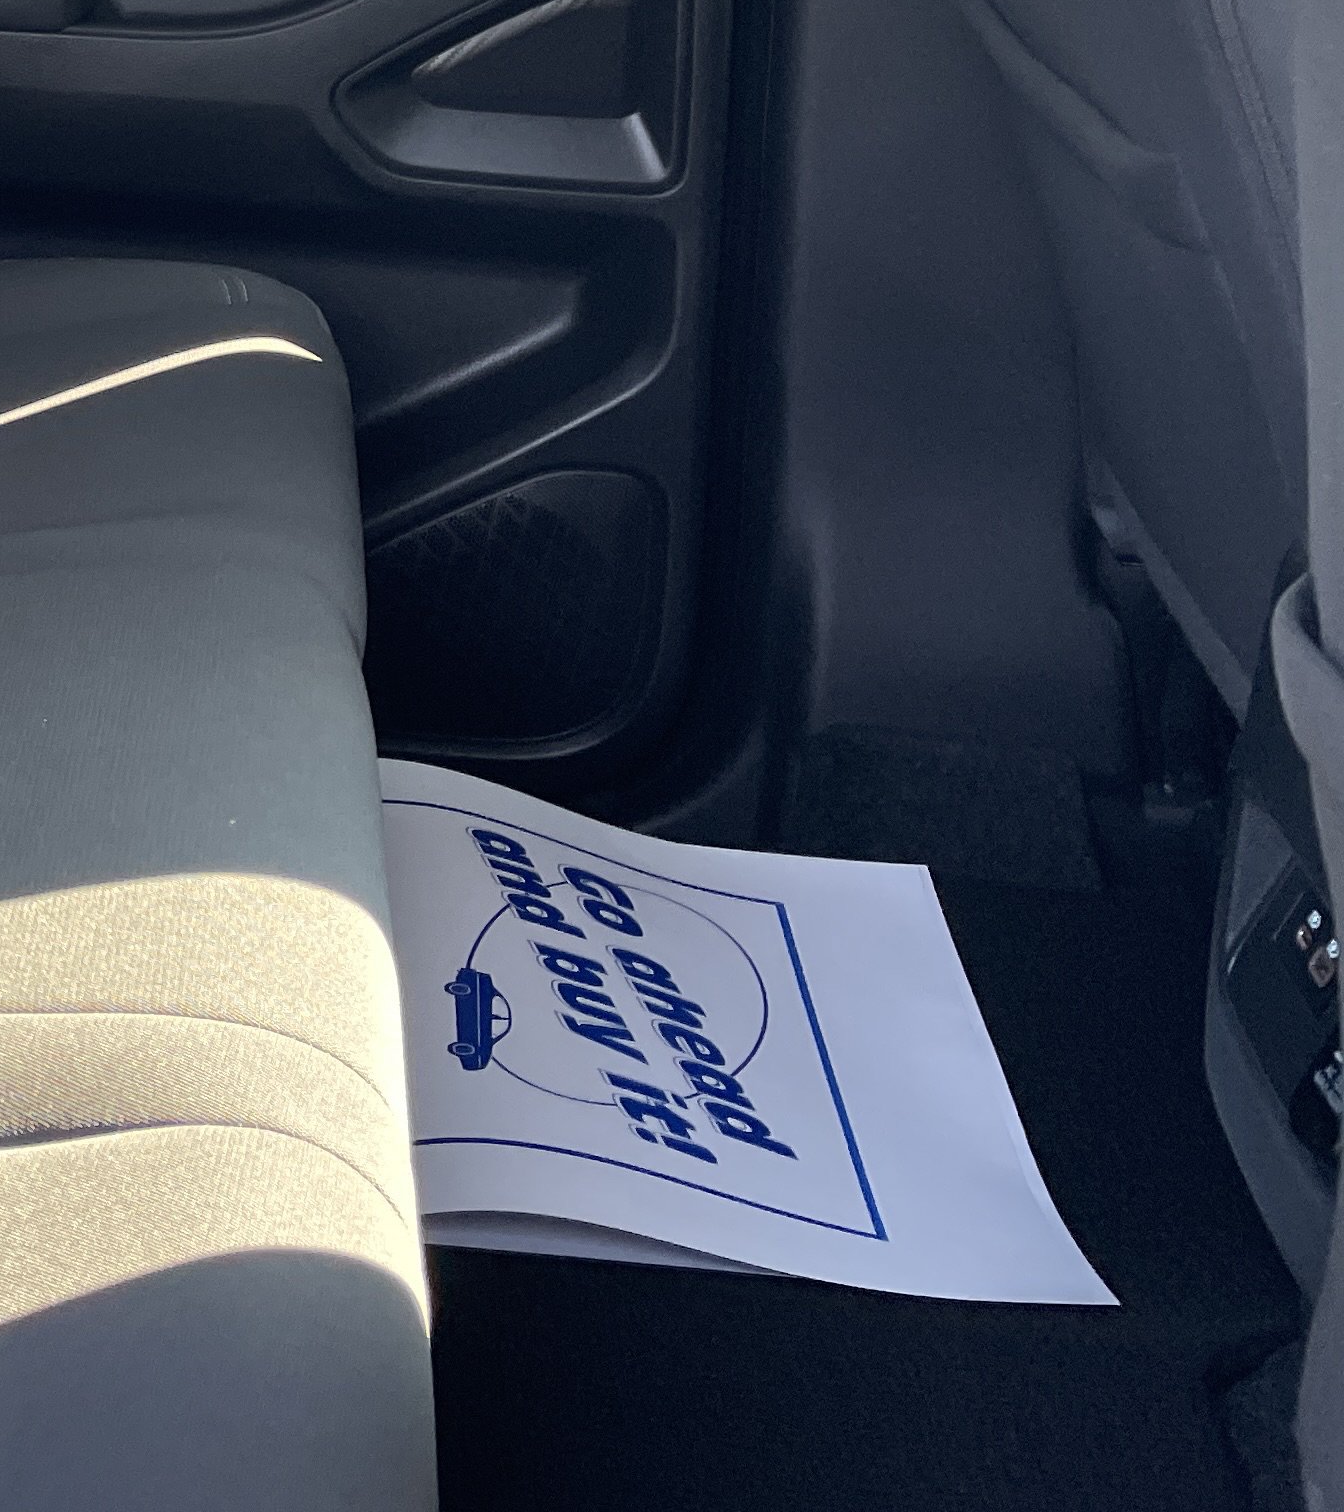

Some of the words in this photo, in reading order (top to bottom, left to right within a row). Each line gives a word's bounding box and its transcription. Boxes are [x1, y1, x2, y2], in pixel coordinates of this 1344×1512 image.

[467, 827, 588, 941] and
[528, 940, 649, 1065] buy
[597, 1068, 719, 1164] it!
[559, 864, 644, 938] Go
[606, 945, 799, 1162] ahead
